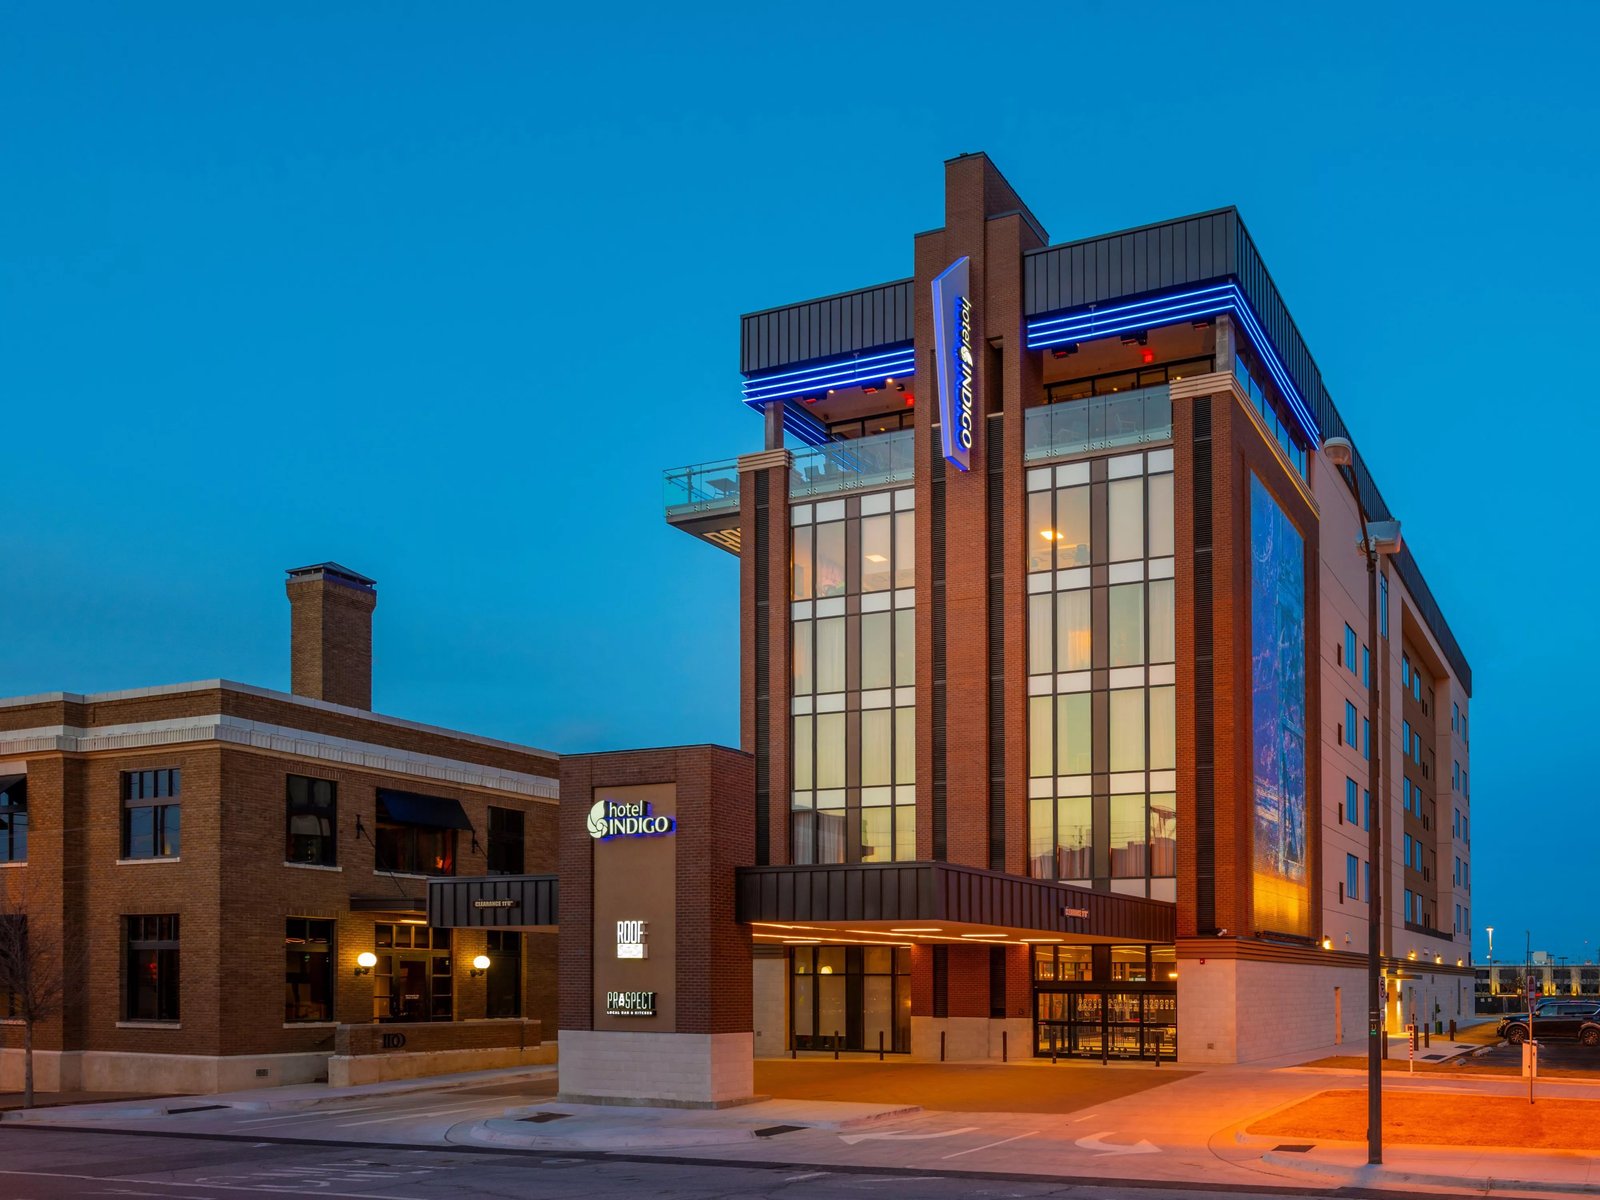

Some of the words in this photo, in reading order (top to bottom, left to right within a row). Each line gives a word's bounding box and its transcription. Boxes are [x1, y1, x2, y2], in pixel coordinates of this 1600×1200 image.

[961, 296, 972, 349] hotel
[961, 363, 973, 449] INDIGO
[609, 800, 643, 817] hotel
[609, 816, 669, 834] INDIGO
[617, 921, 644, 944] ROOF
